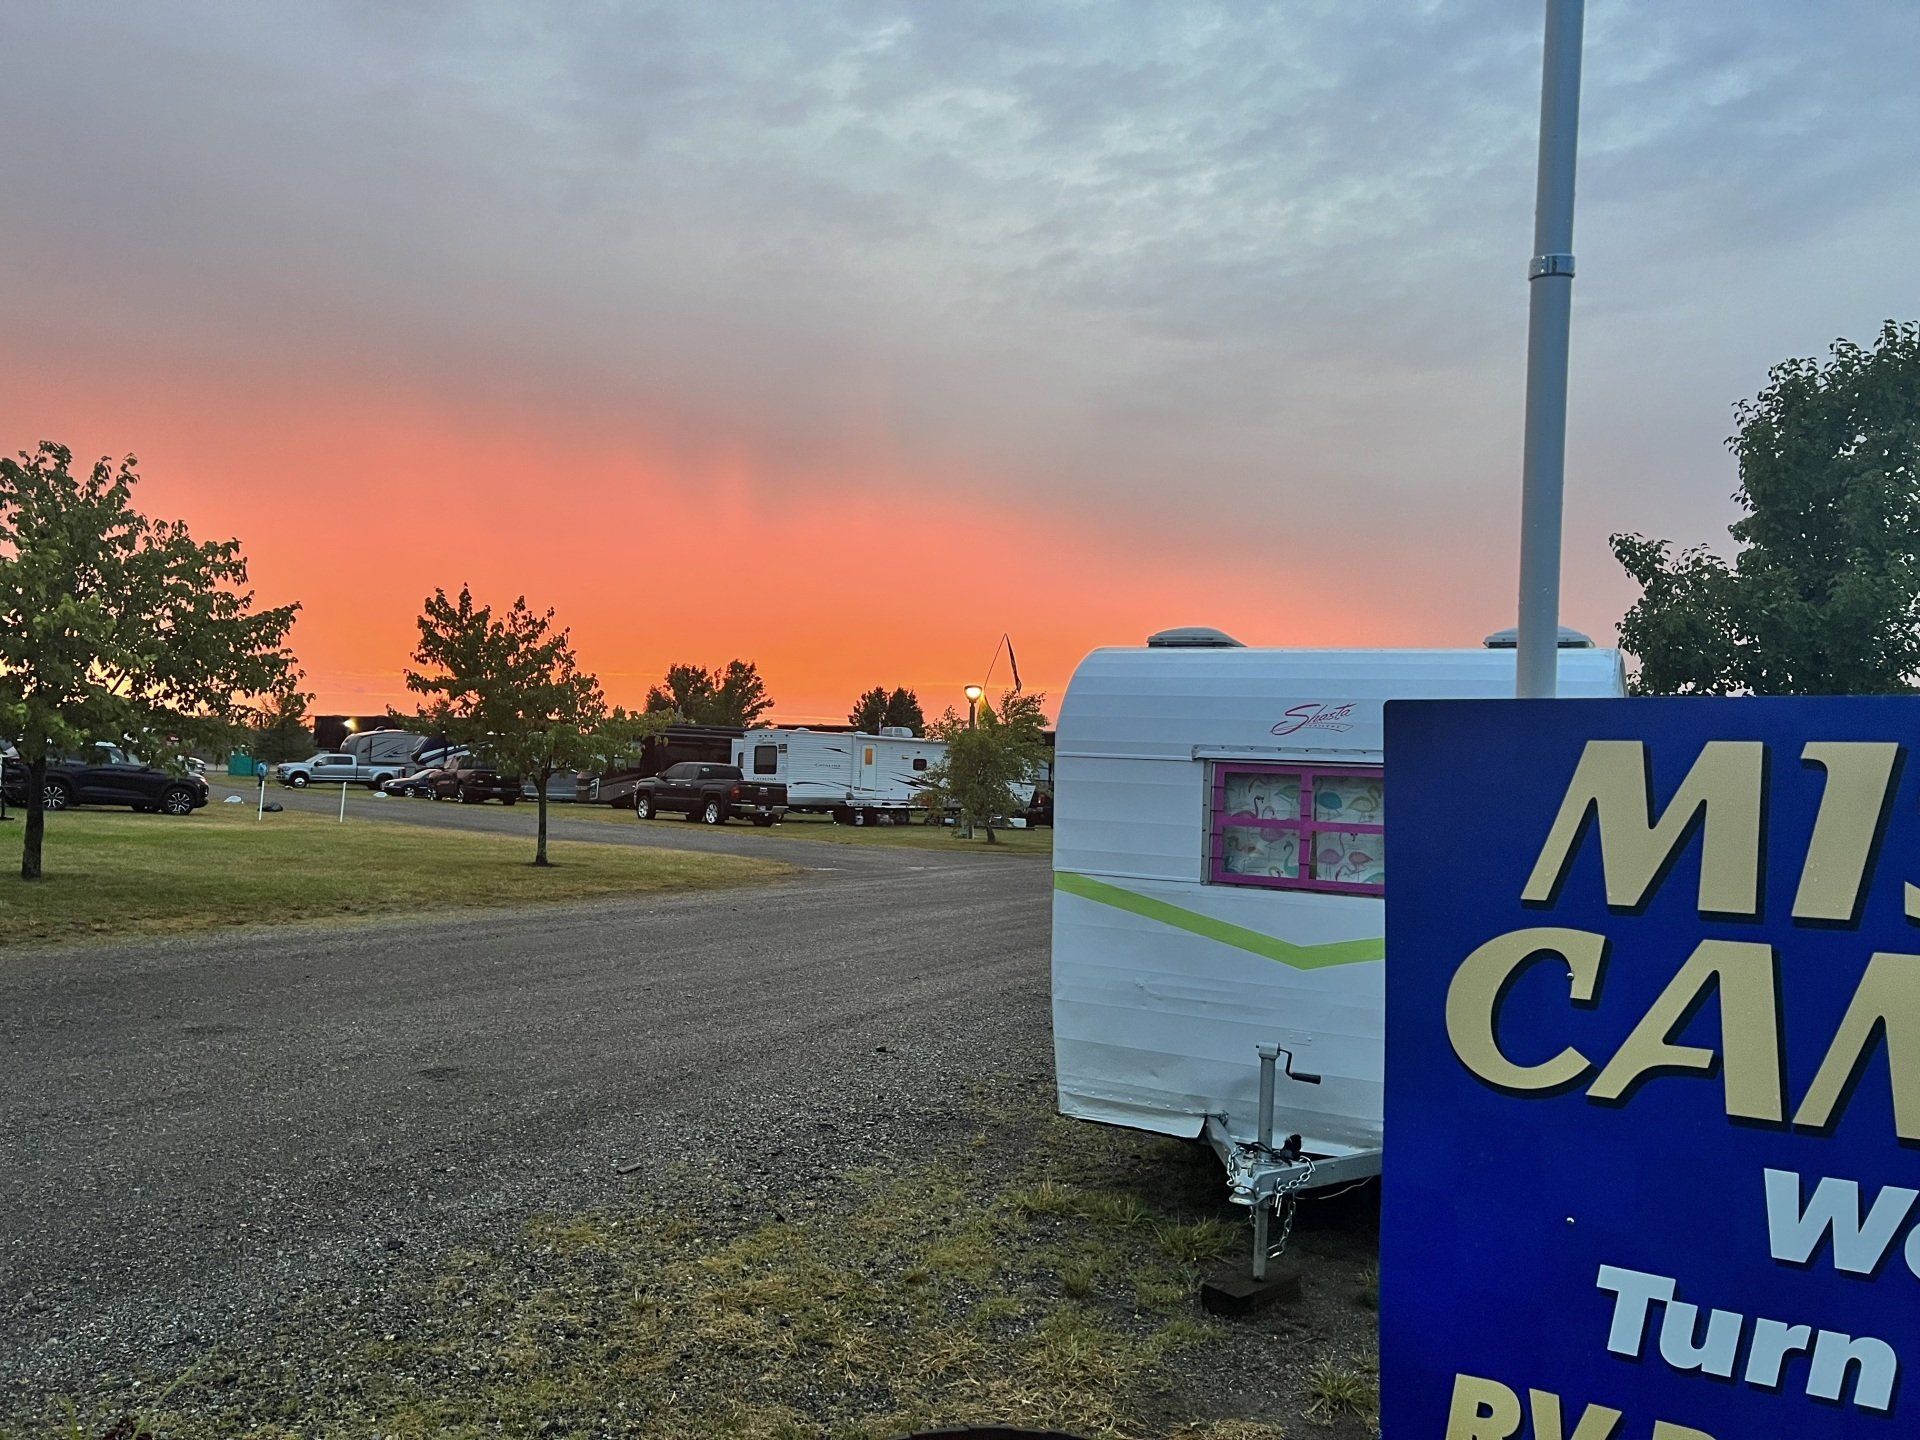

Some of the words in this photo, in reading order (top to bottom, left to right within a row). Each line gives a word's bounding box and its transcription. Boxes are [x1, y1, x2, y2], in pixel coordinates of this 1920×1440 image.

[1270, 703, 1357, 735] Shasta
[1520, 740, 1920, 921] MI
[1764, 1168, 1920, 1280] W
[1596, 1264, 1898, 1411] Turn
